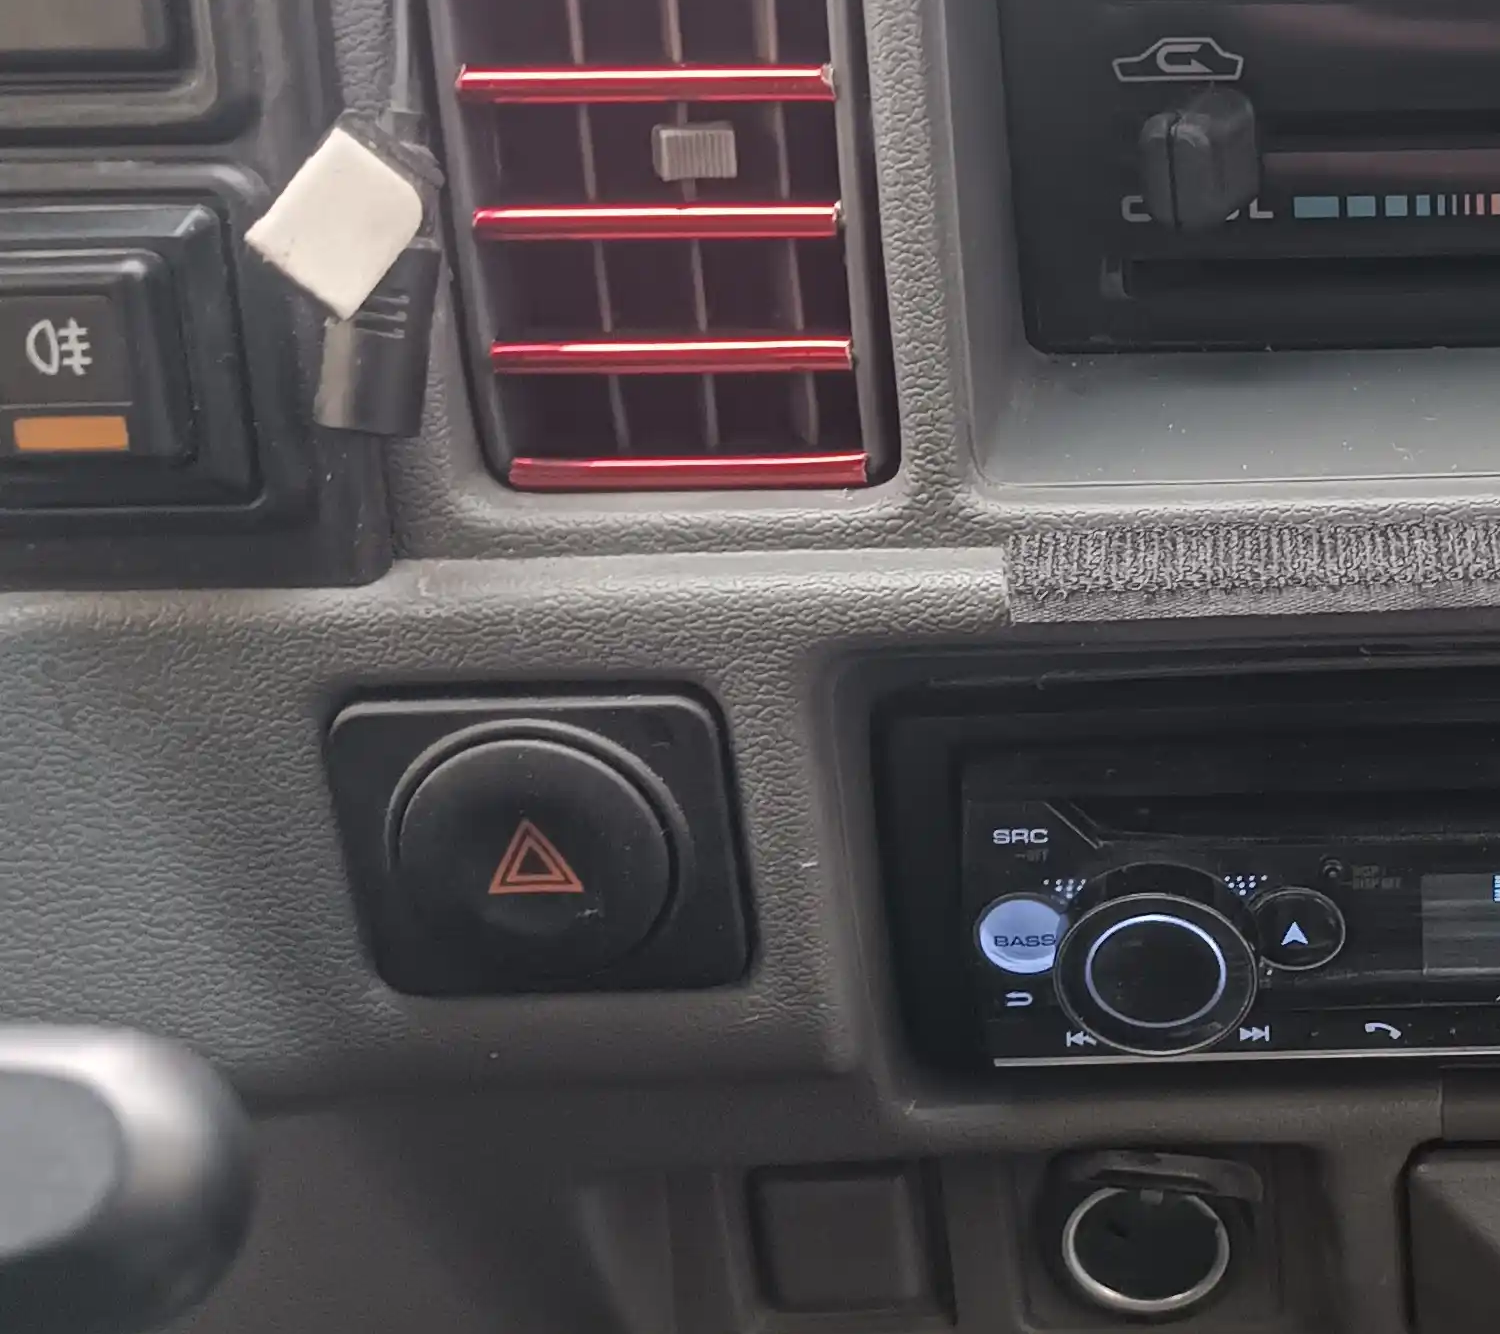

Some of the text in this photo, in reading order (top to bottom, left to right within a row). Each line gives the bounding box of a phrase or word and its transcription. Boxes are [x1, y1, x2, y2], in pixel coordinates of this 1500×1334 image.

[1121, 194, 1274, 223] CL
[992, 828, 1050, 845] SRC
[994, 934, 1058, 948] BASS
